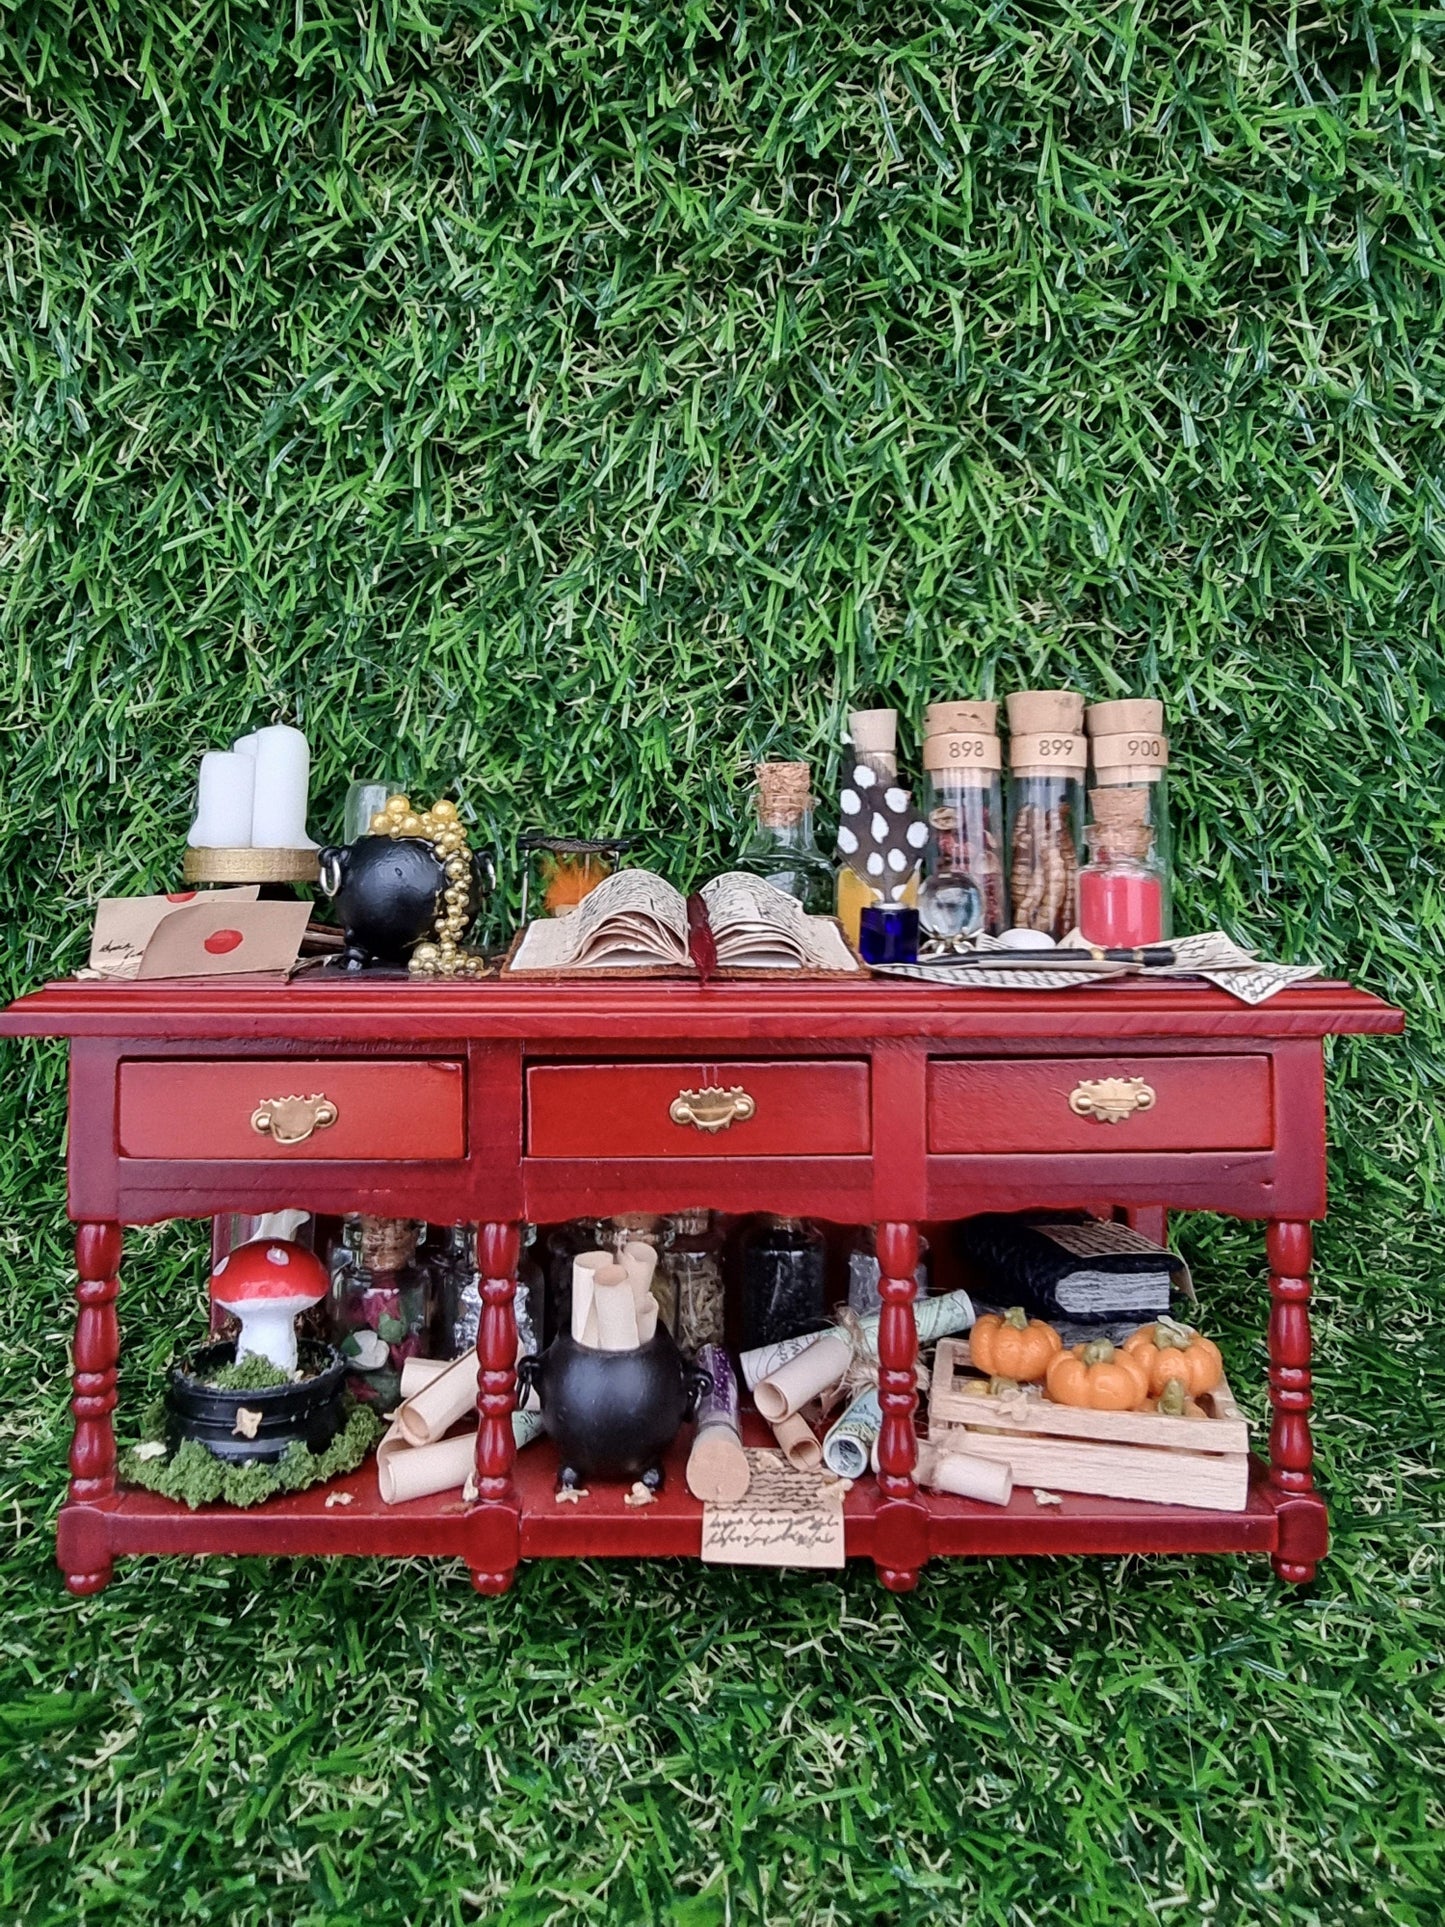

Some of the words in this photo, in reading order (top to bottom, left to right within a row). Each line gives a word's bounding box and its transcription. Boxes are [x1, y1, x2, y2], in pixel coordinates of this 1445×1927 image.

[949, 740, 985, 758] 898
[1038, 739, 1074, 756] 899
[1127, 739, 1161, 757] 900
